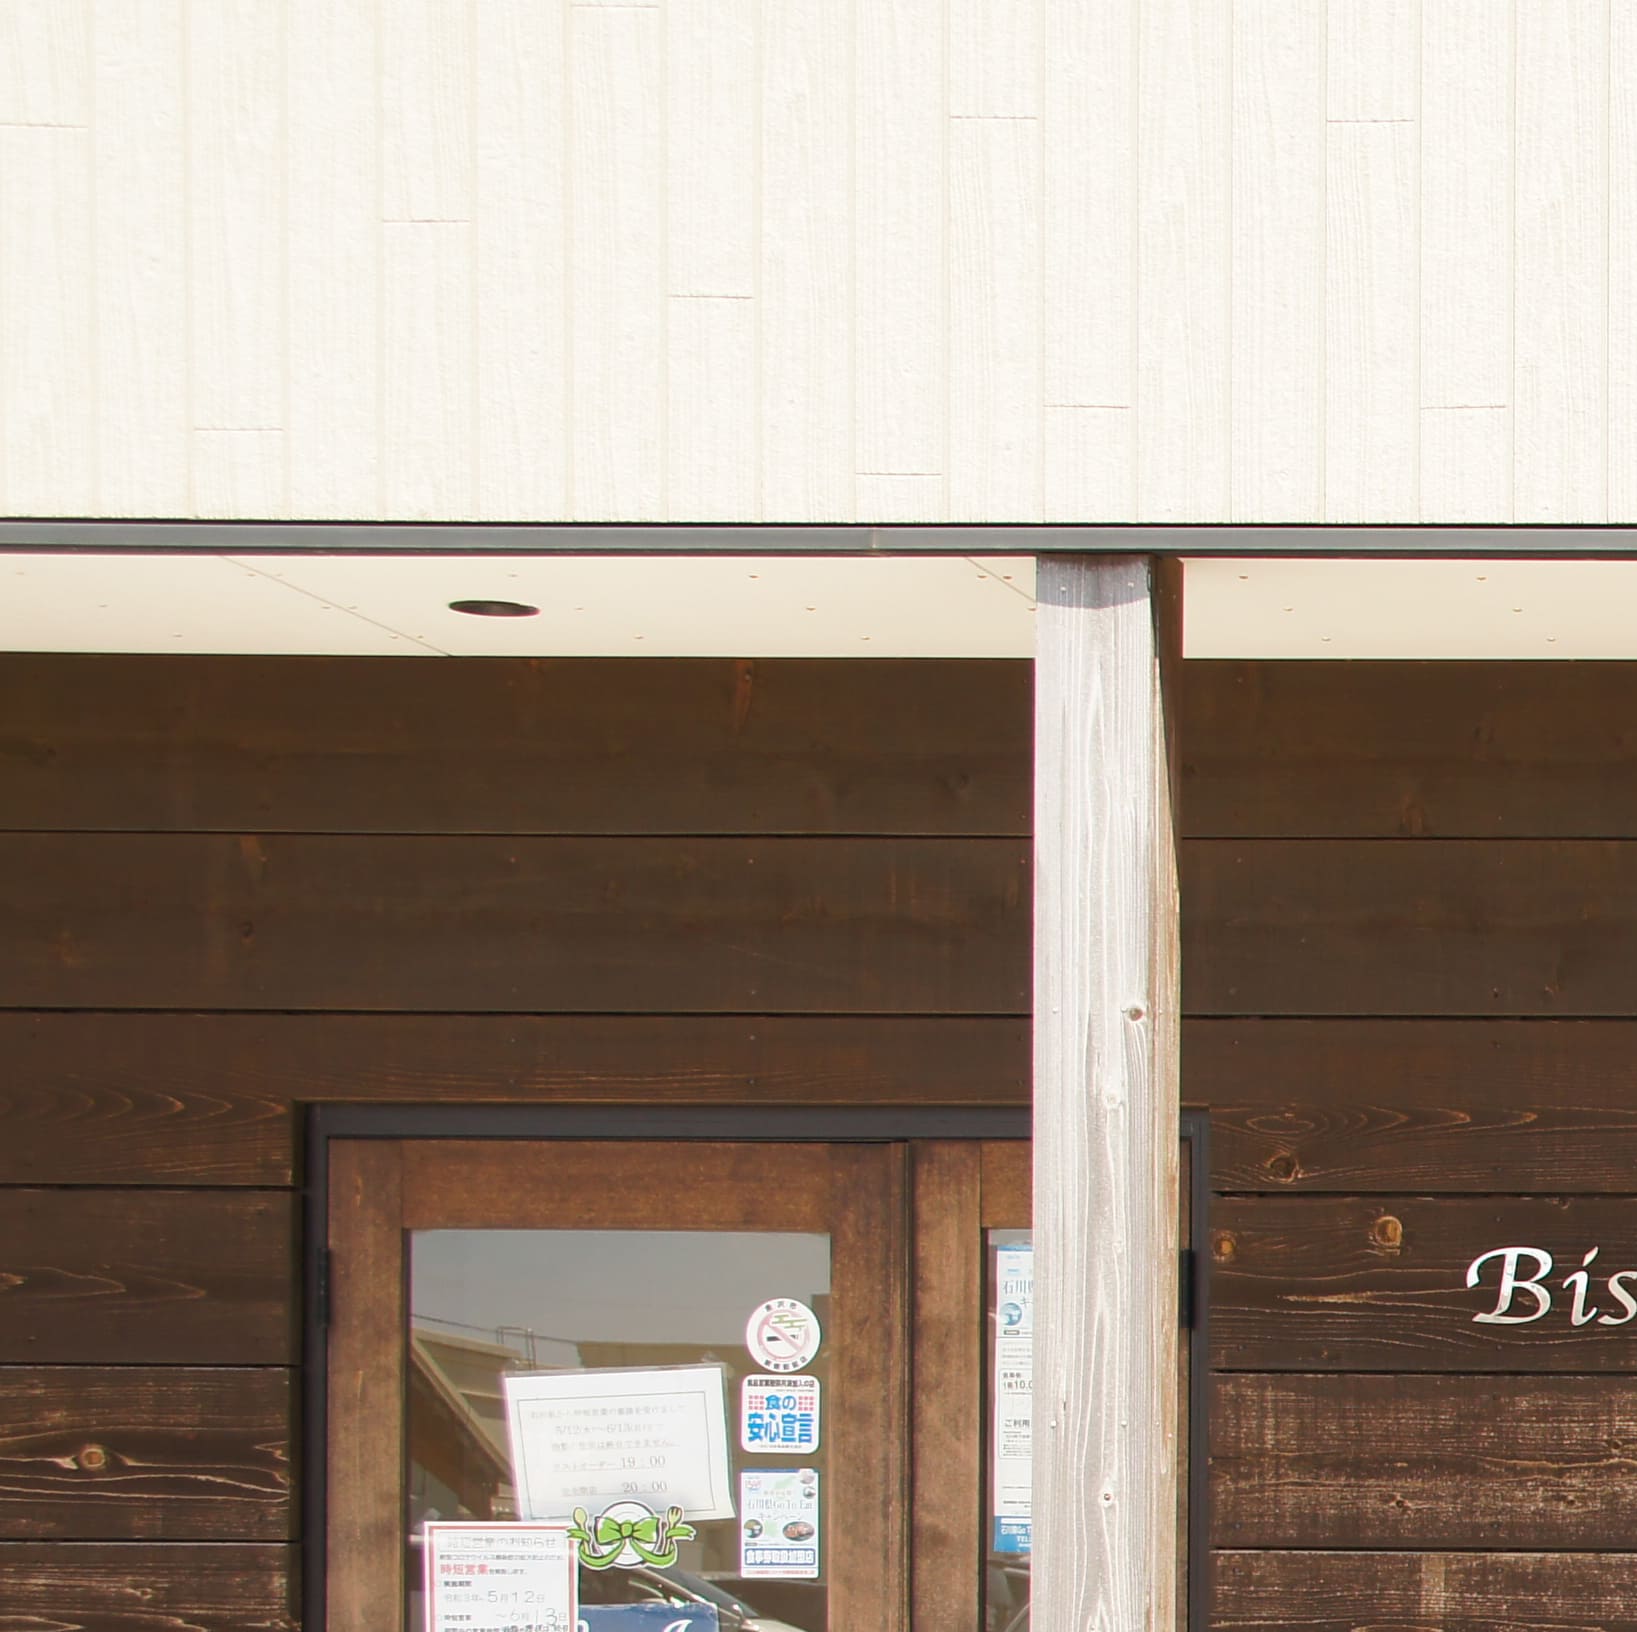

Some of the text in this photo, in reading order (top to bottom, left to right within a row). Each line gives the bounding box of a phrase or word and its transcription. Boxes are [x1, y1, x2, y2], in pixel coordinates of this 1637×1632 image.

[765, 1395, 797, 1411] 食の
[748, 1412, 814, 1443] 安心宣言
